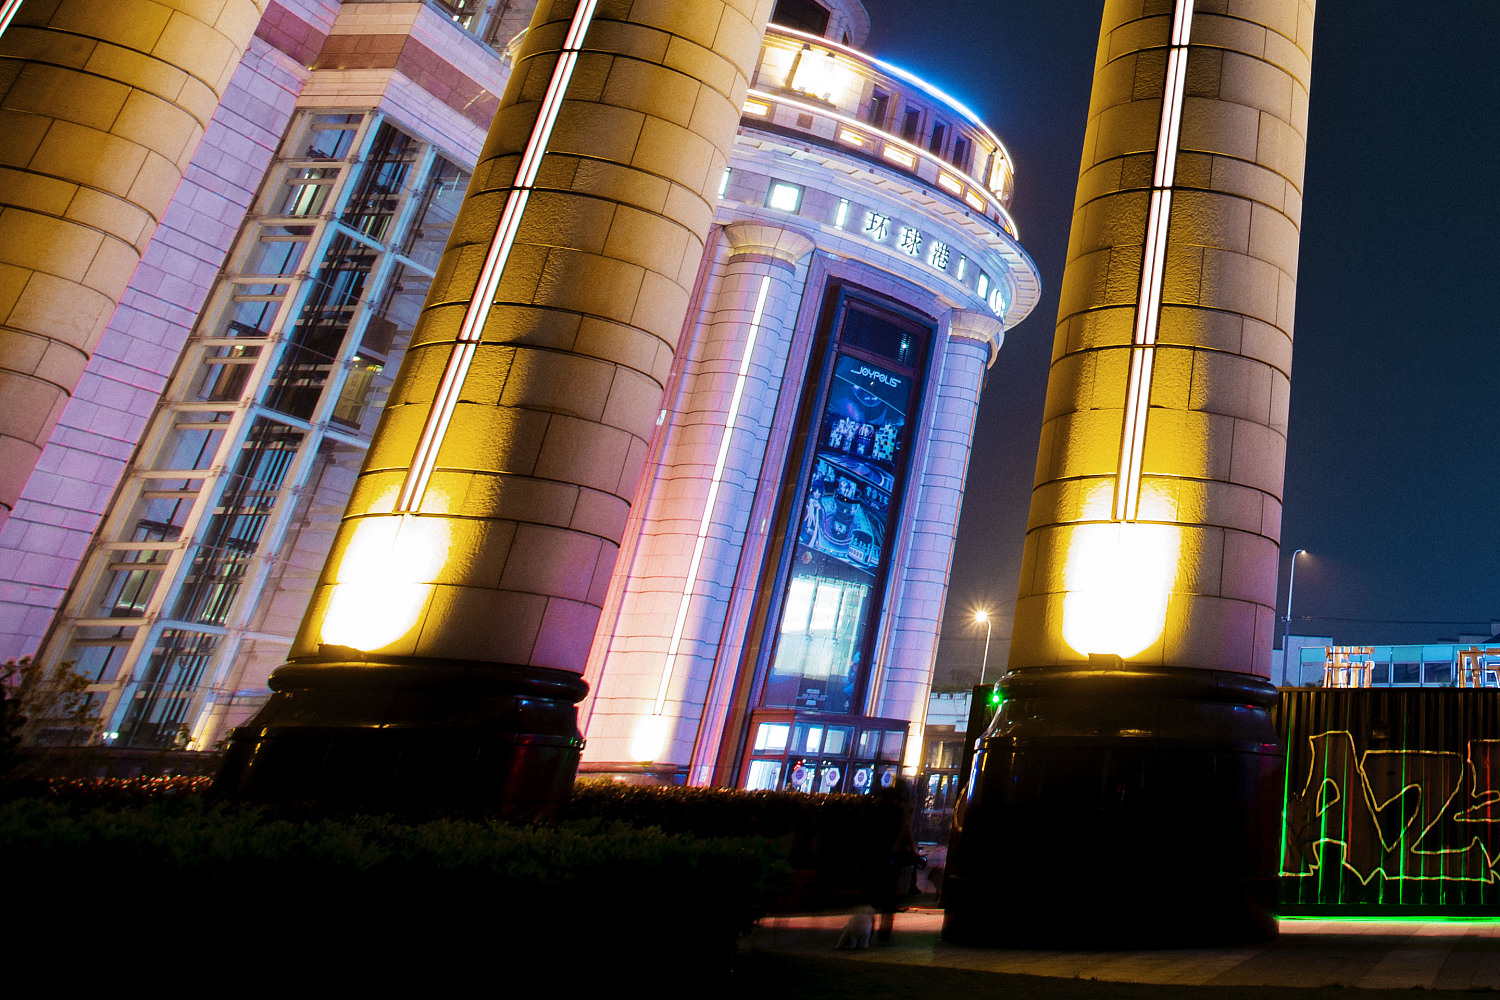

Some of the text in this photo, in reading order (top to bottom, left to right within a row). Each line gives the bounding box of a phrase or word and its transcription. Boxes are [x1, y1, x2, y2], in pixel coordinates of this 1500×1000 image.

[865, 211, 951, 270] 环球港
[850, 366, 902, 388] JOYPOLIS
